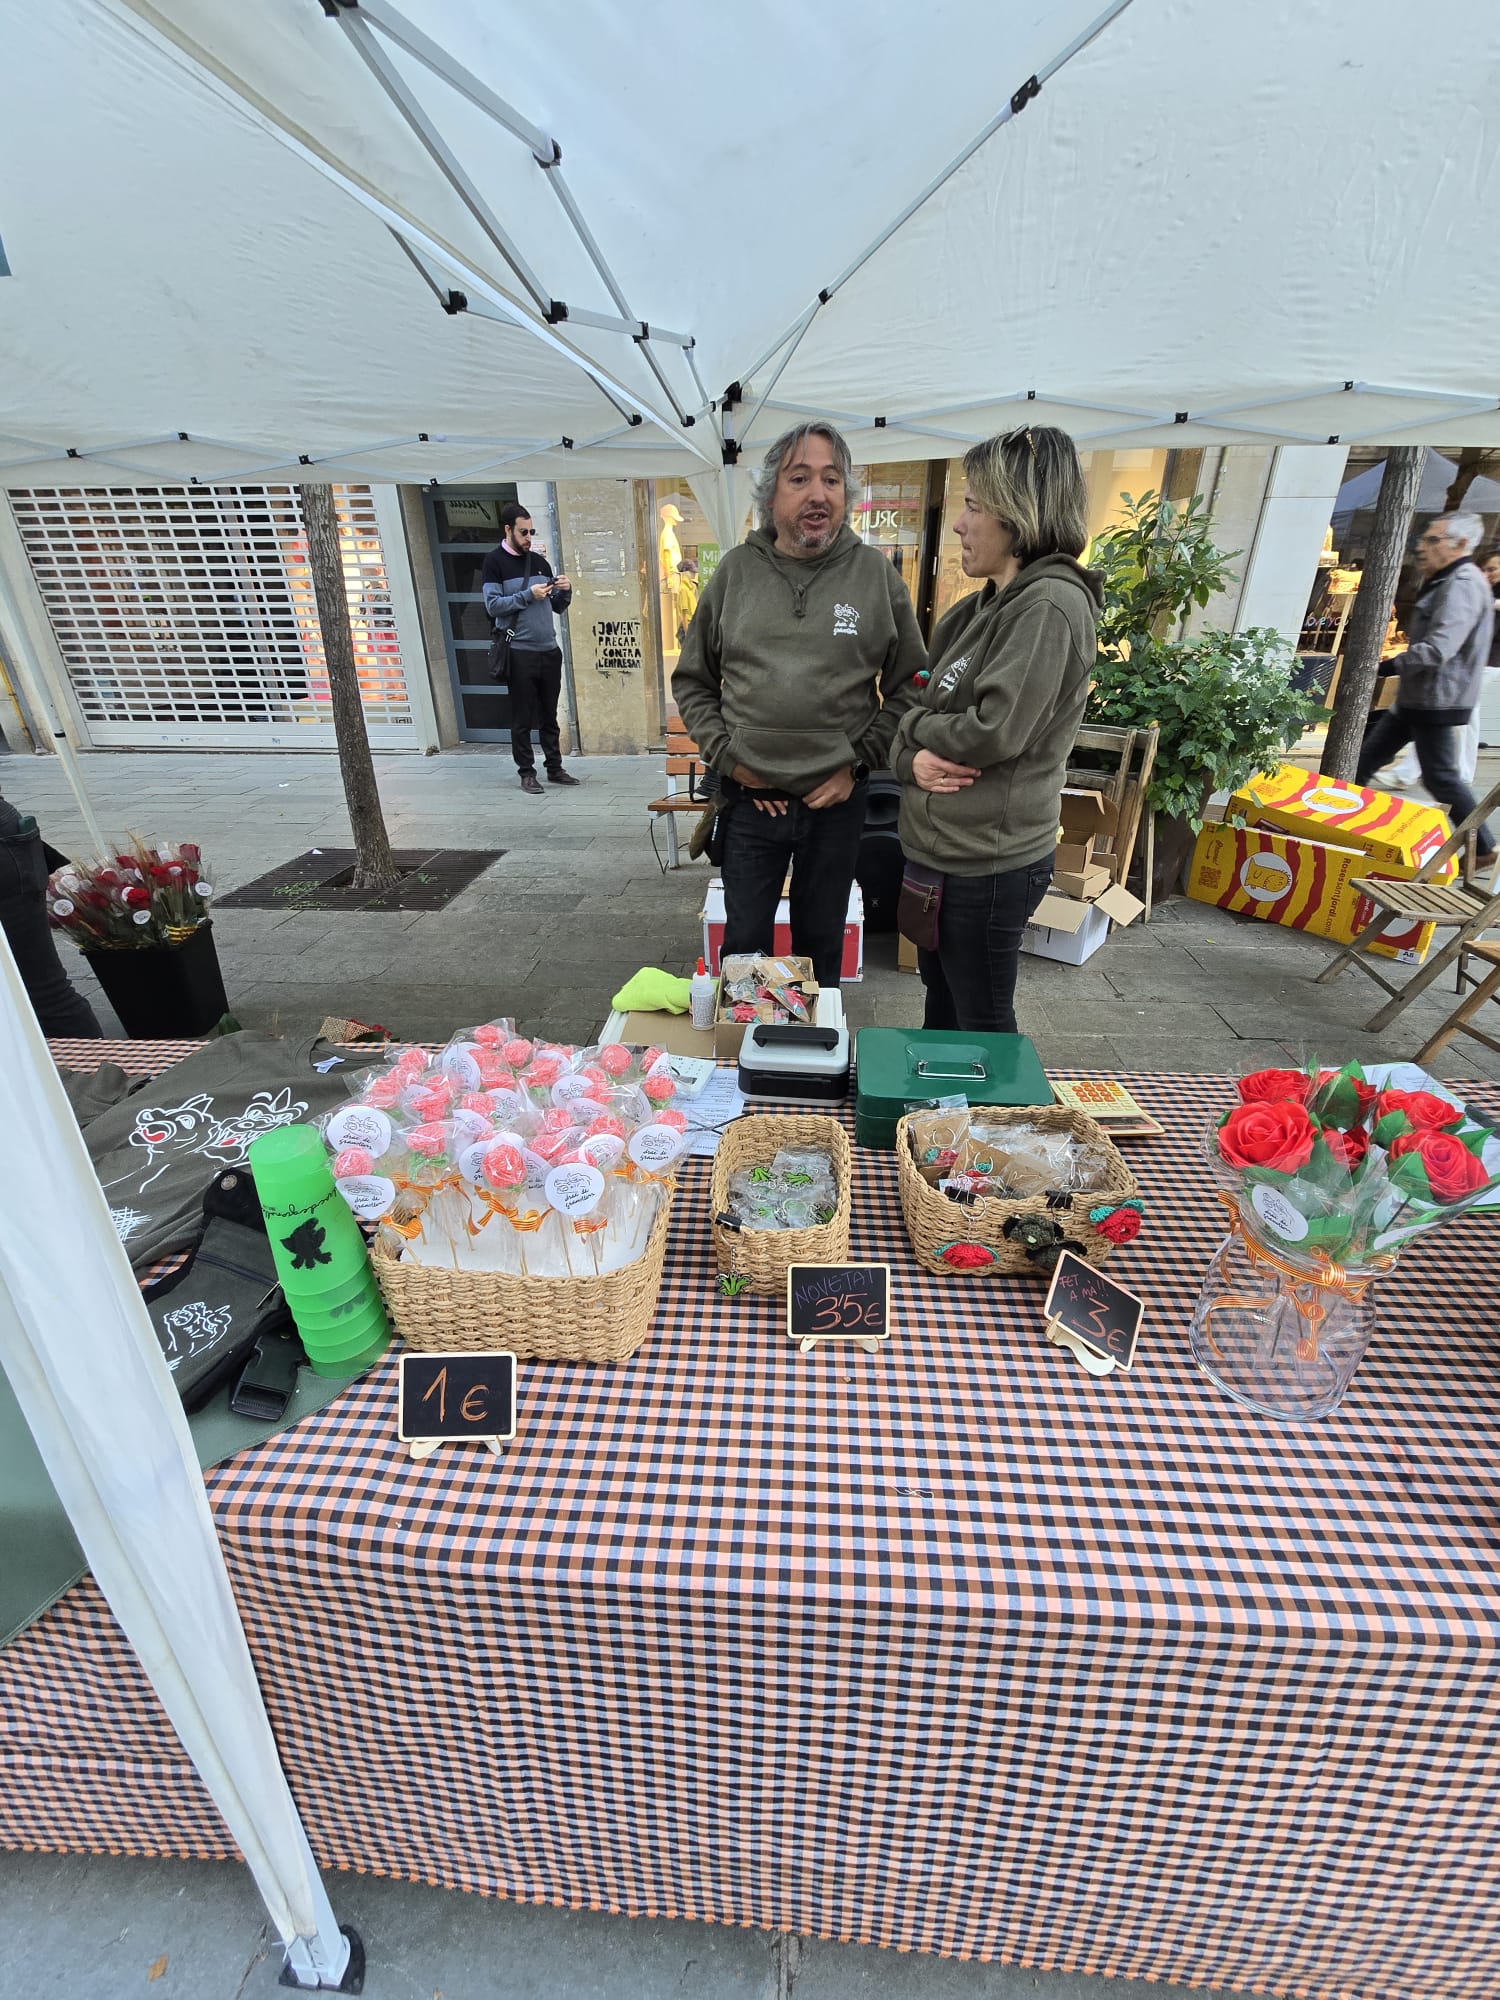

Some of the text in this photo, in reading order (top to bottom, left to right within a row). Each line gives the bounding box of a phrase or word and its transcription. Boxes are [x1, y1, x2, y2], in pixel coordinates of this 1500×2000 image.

[598, 621, 640, 635] JOVENT
[603, 648, 641, 657] CONTRA
[1059, 1274, 1079, 1289] FET
[795, 1268, 874, 1310] NOVETAT
[1069, 1289, 1078, 1302] A
